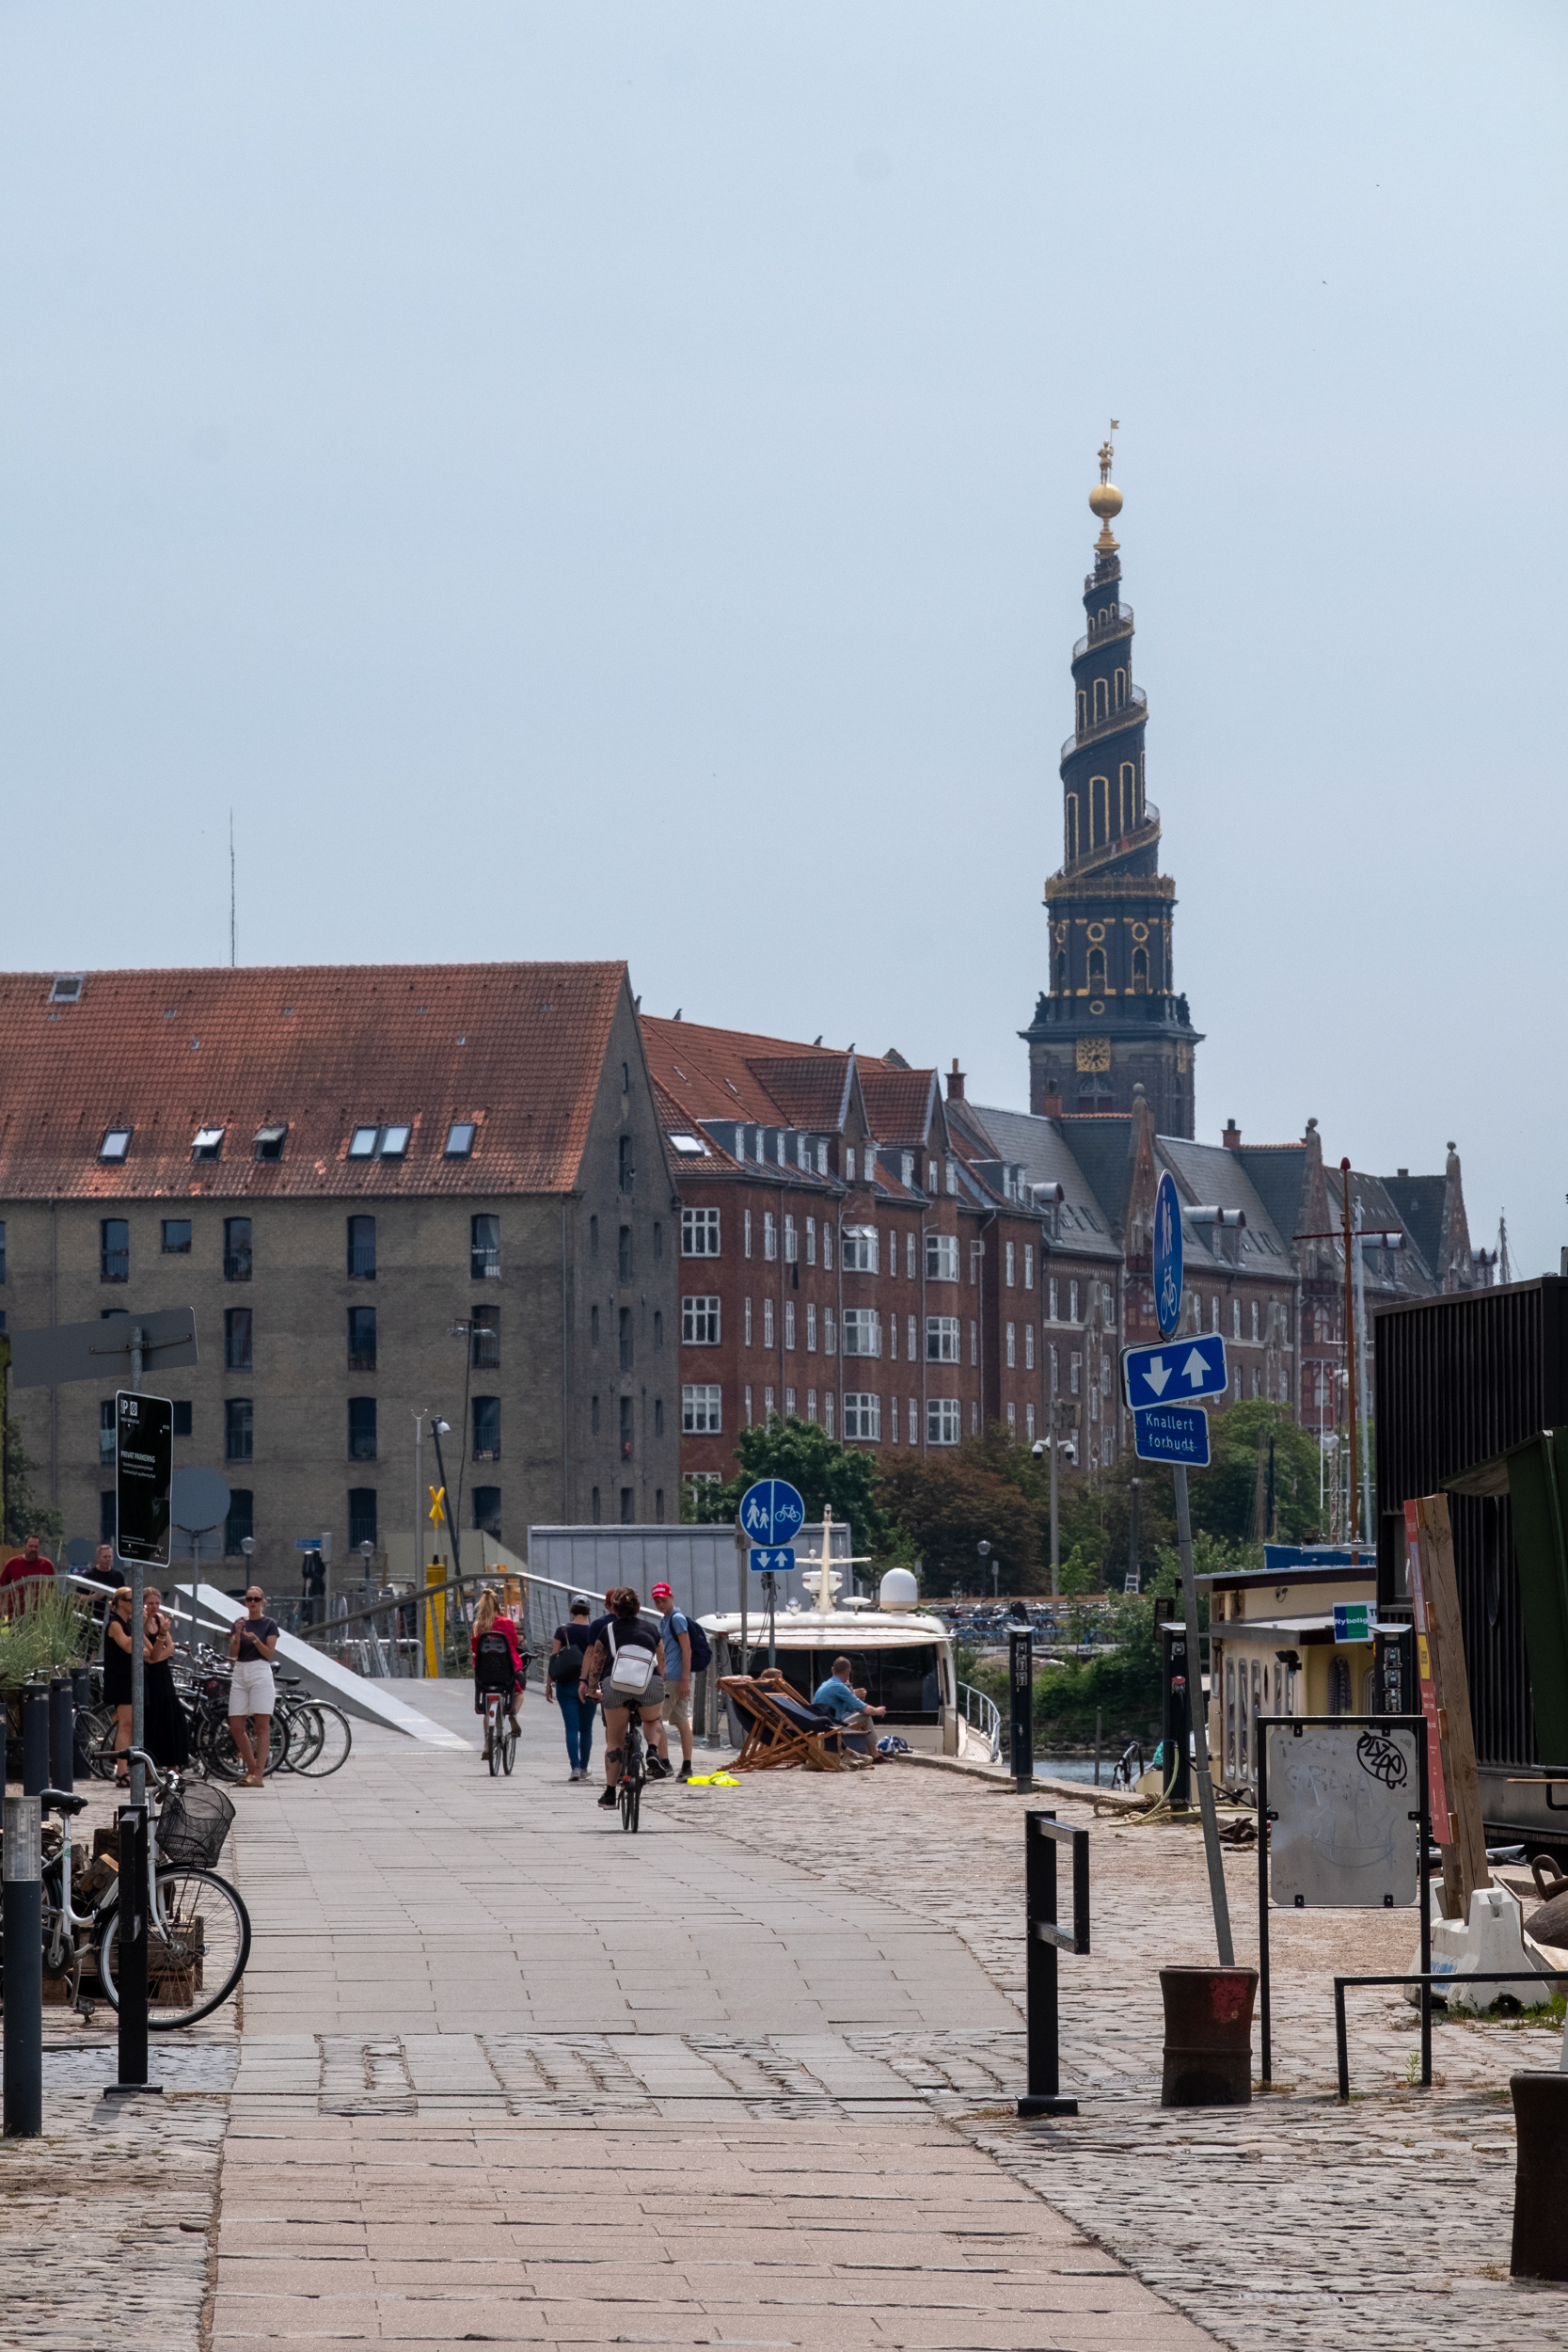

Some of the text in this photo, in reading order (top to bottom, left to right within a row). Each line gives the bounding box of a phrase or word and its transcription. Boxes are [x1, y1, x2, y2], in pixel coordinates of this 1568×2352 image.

[1146, 1413, 1194, 1431] Knallert
[1148, 1433, 1195, 1452] forbudt
[120, 1450, 156, 1463] PRIVAT PARKERING
[1335, 1617, 1368, 1626] Nybolig
